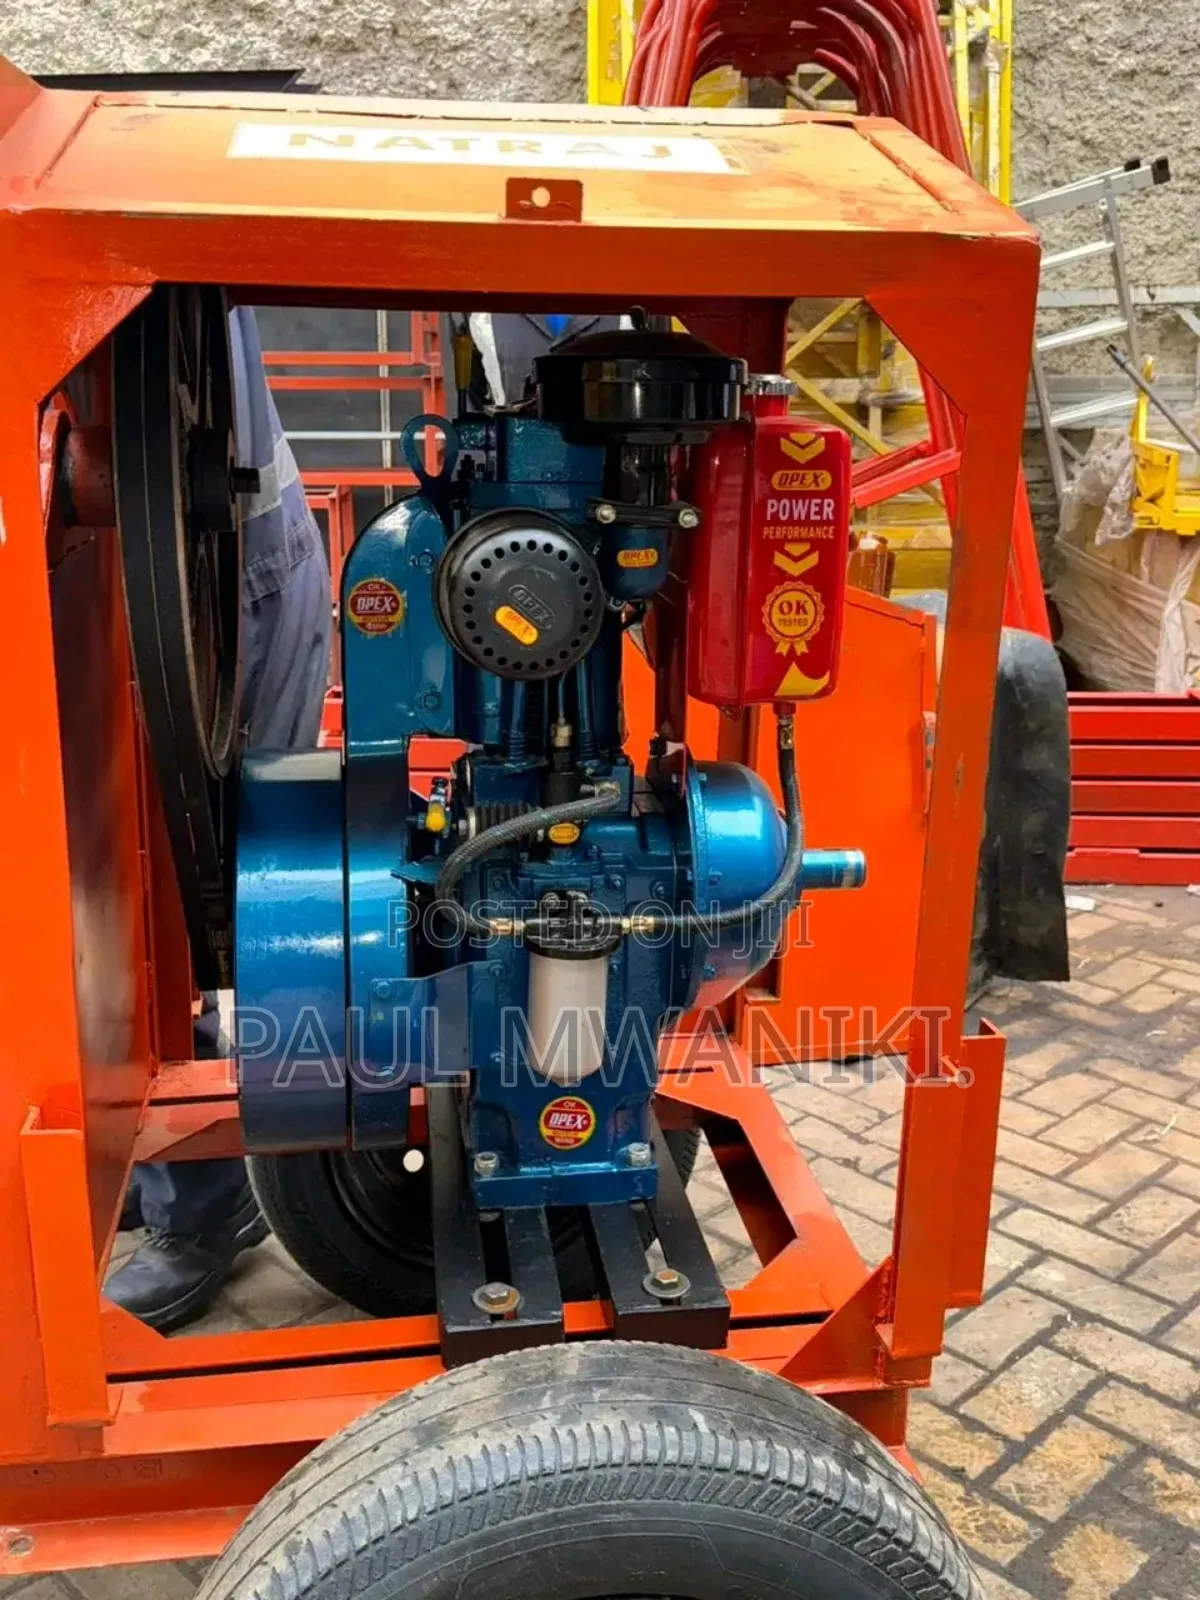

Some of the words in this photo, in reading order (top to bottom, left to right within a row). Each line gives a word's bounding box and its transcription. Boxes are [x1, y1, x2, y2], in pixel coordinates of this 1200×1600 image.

[287, 132, 674, 158] NATRAJ
[766, 499, 835, 521] POWER
[763, 525, 836, 539] PERFORMANCE
[778, 600, 808, 616] OK
